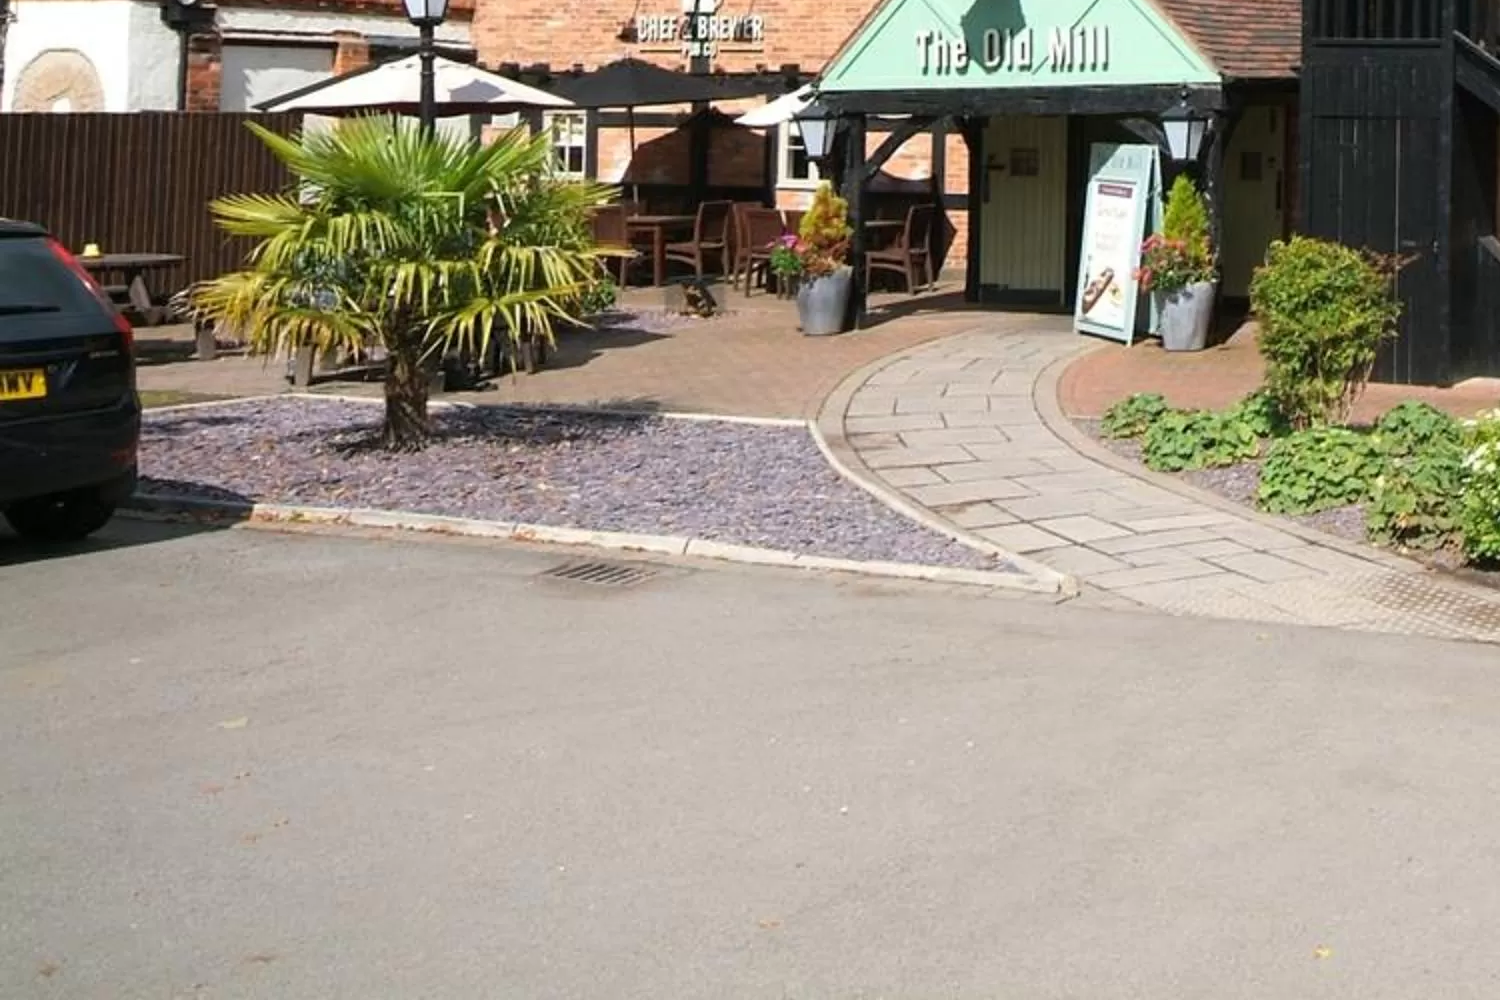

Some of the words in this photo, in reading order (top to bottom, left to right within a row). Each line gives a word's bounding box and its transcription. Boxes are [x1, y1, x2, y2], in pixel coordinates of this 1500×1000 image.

[637, 15, 680, 40] CHEF
[697, 15, 764, 41] BREWER
[915, 30, 969, 73] The
[984, 27, 1034, 71] Old
[1048, 26, 1109, 71] Mill
